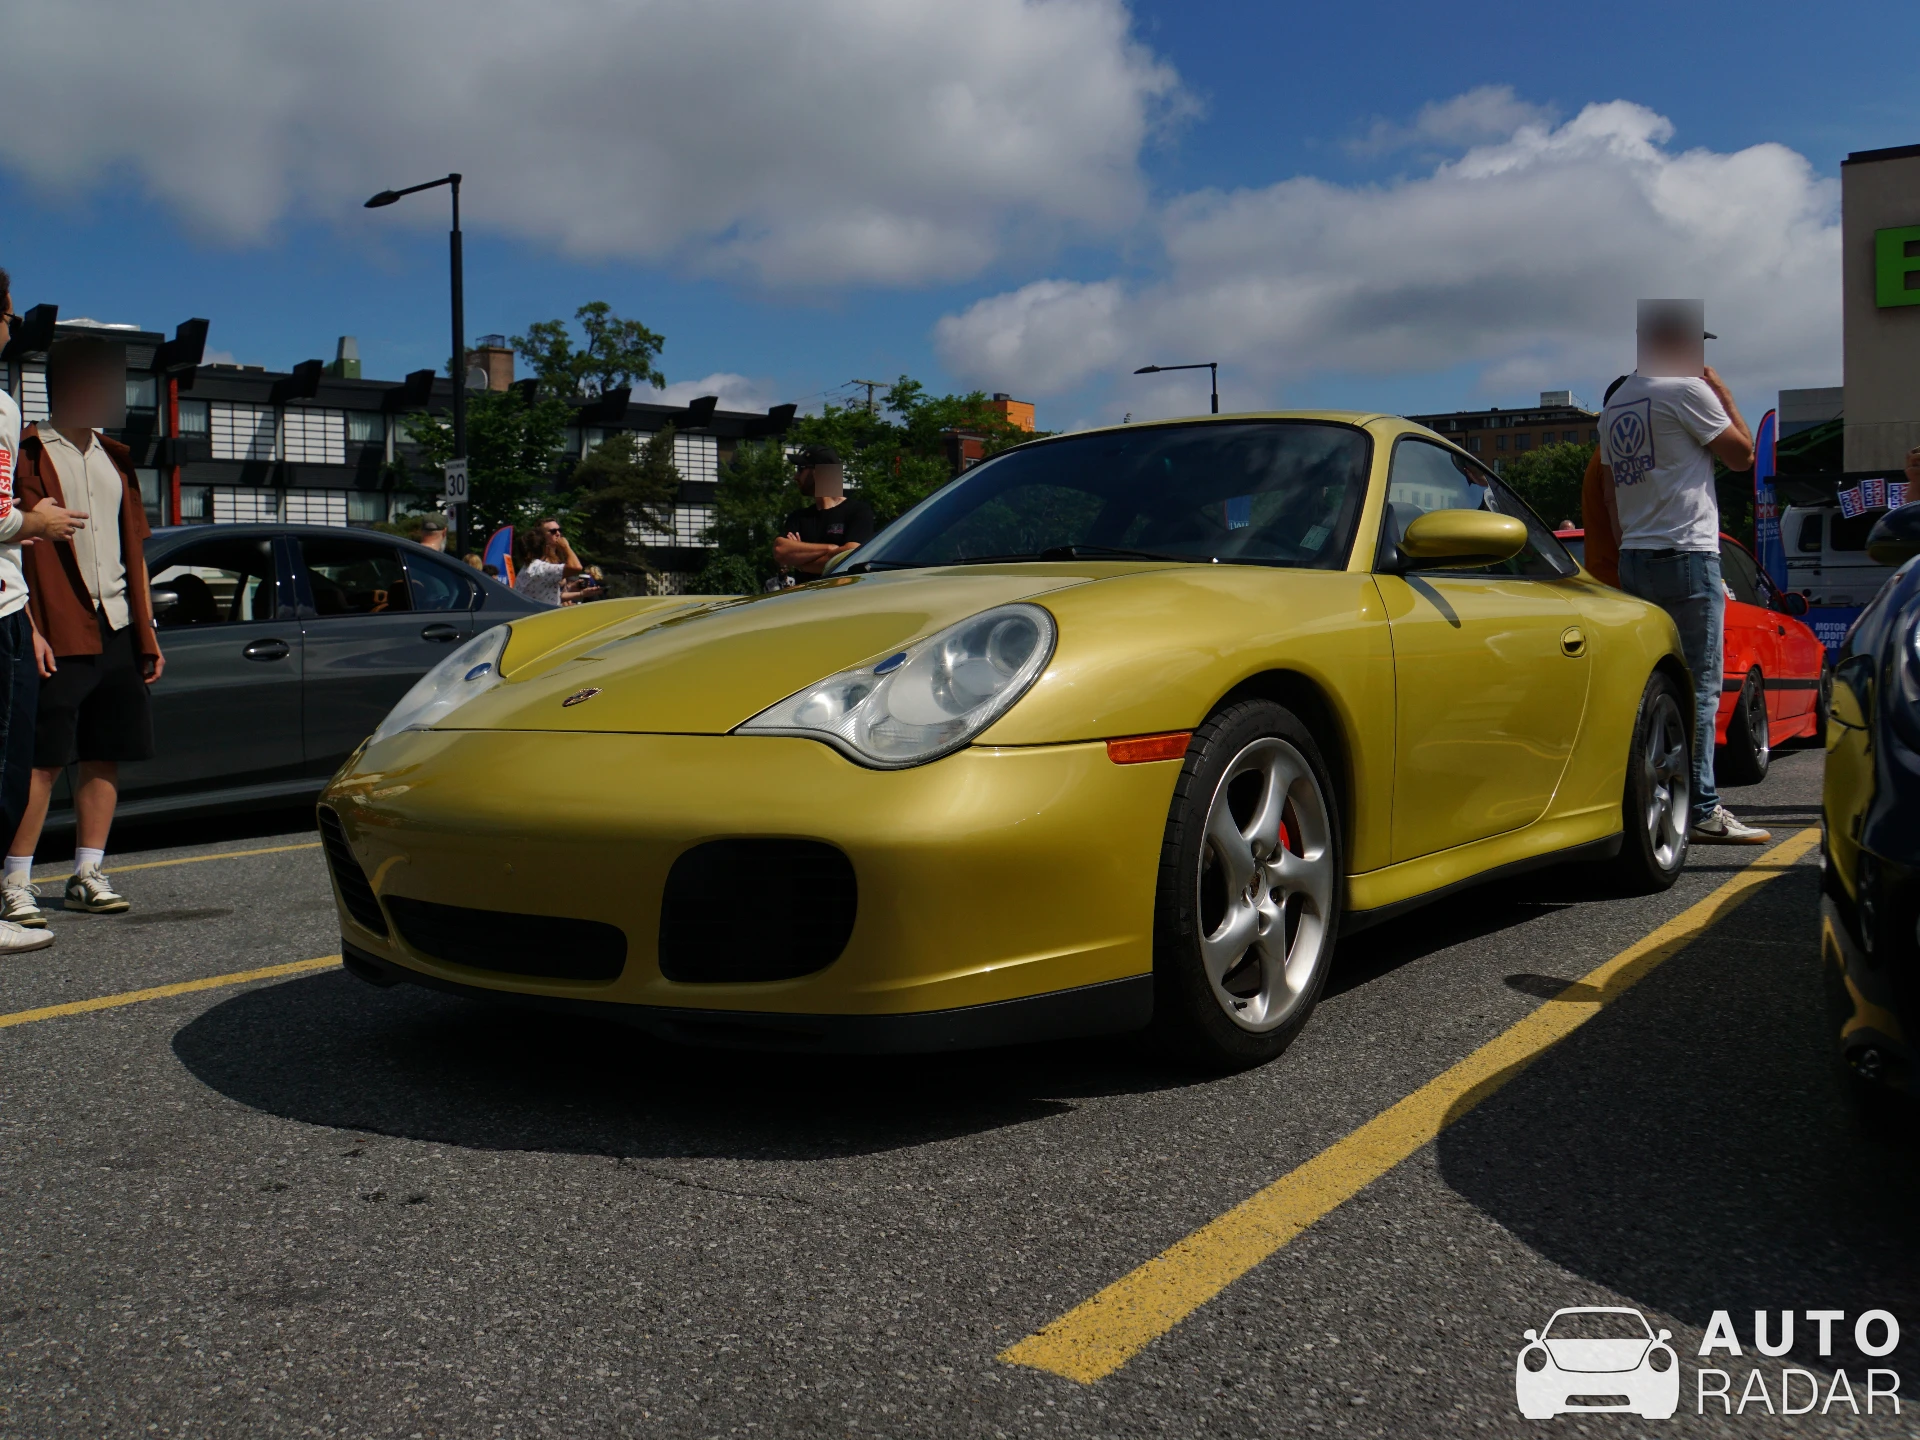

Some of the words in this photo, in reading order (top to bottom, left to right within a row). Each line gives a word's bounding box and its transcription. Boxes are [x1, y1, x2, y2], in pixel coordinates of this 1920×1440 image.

[1614, 455, 1652, 474] MOTOR
[448, 473, 464, 497] 30
[1815, 622, 1847, 631] MOTOR
